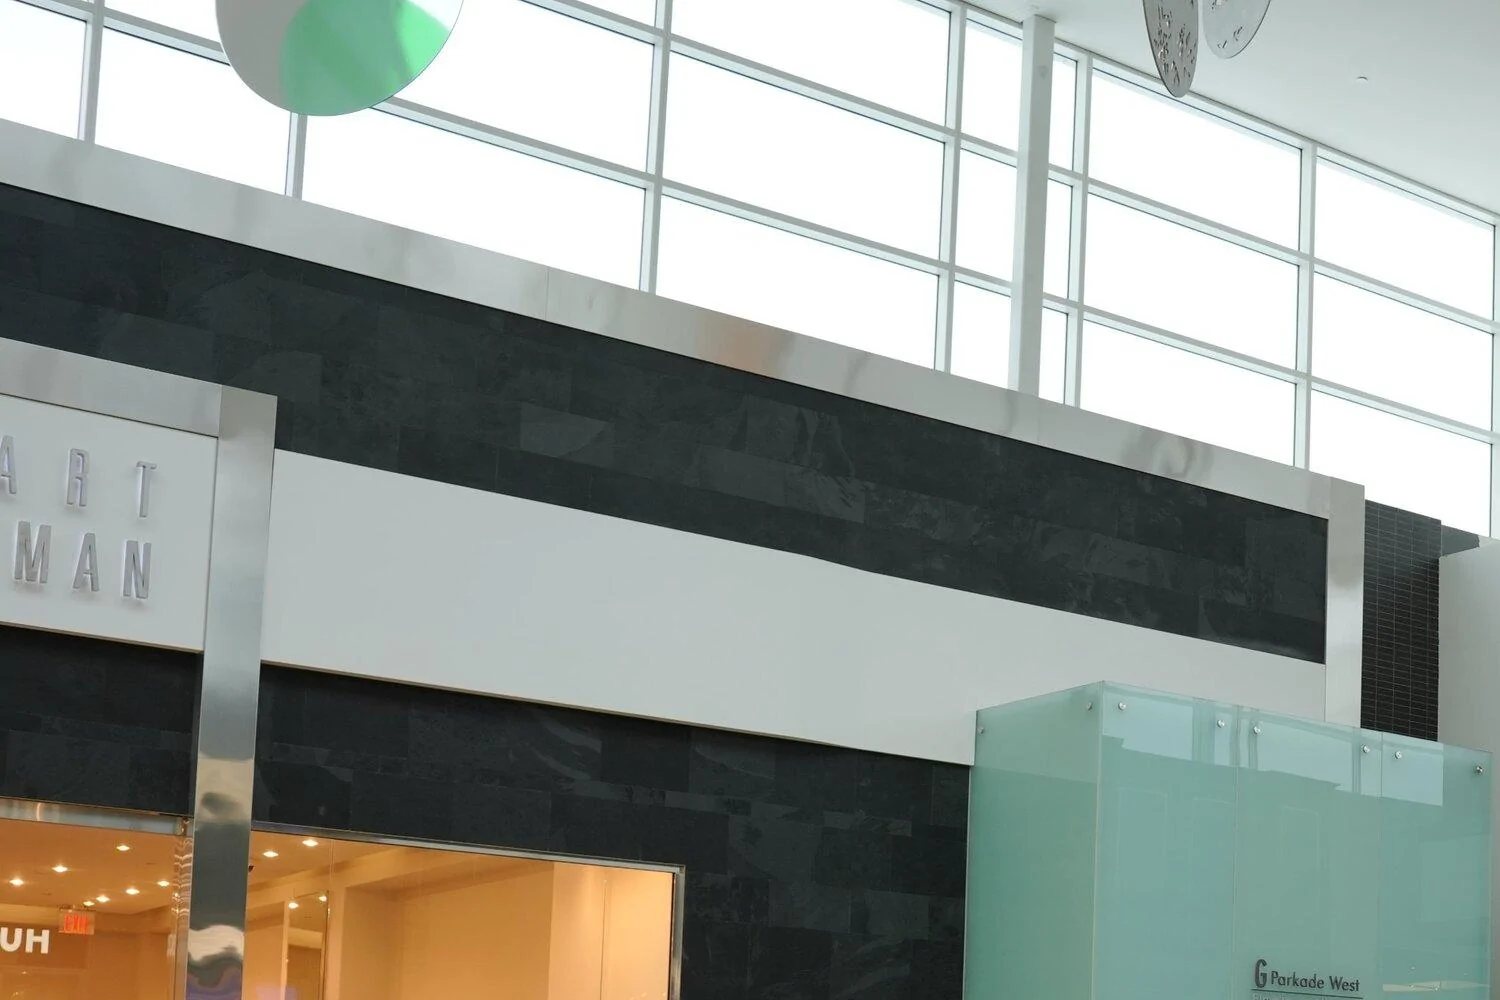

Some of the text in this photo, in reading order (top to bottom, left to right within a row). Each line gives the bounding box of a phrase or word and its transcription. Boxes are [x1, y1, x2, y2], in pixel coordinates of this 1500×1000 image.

[14, 520, 151, 598] MAN
[1255, 959, 1360, 992] G Parkade West
